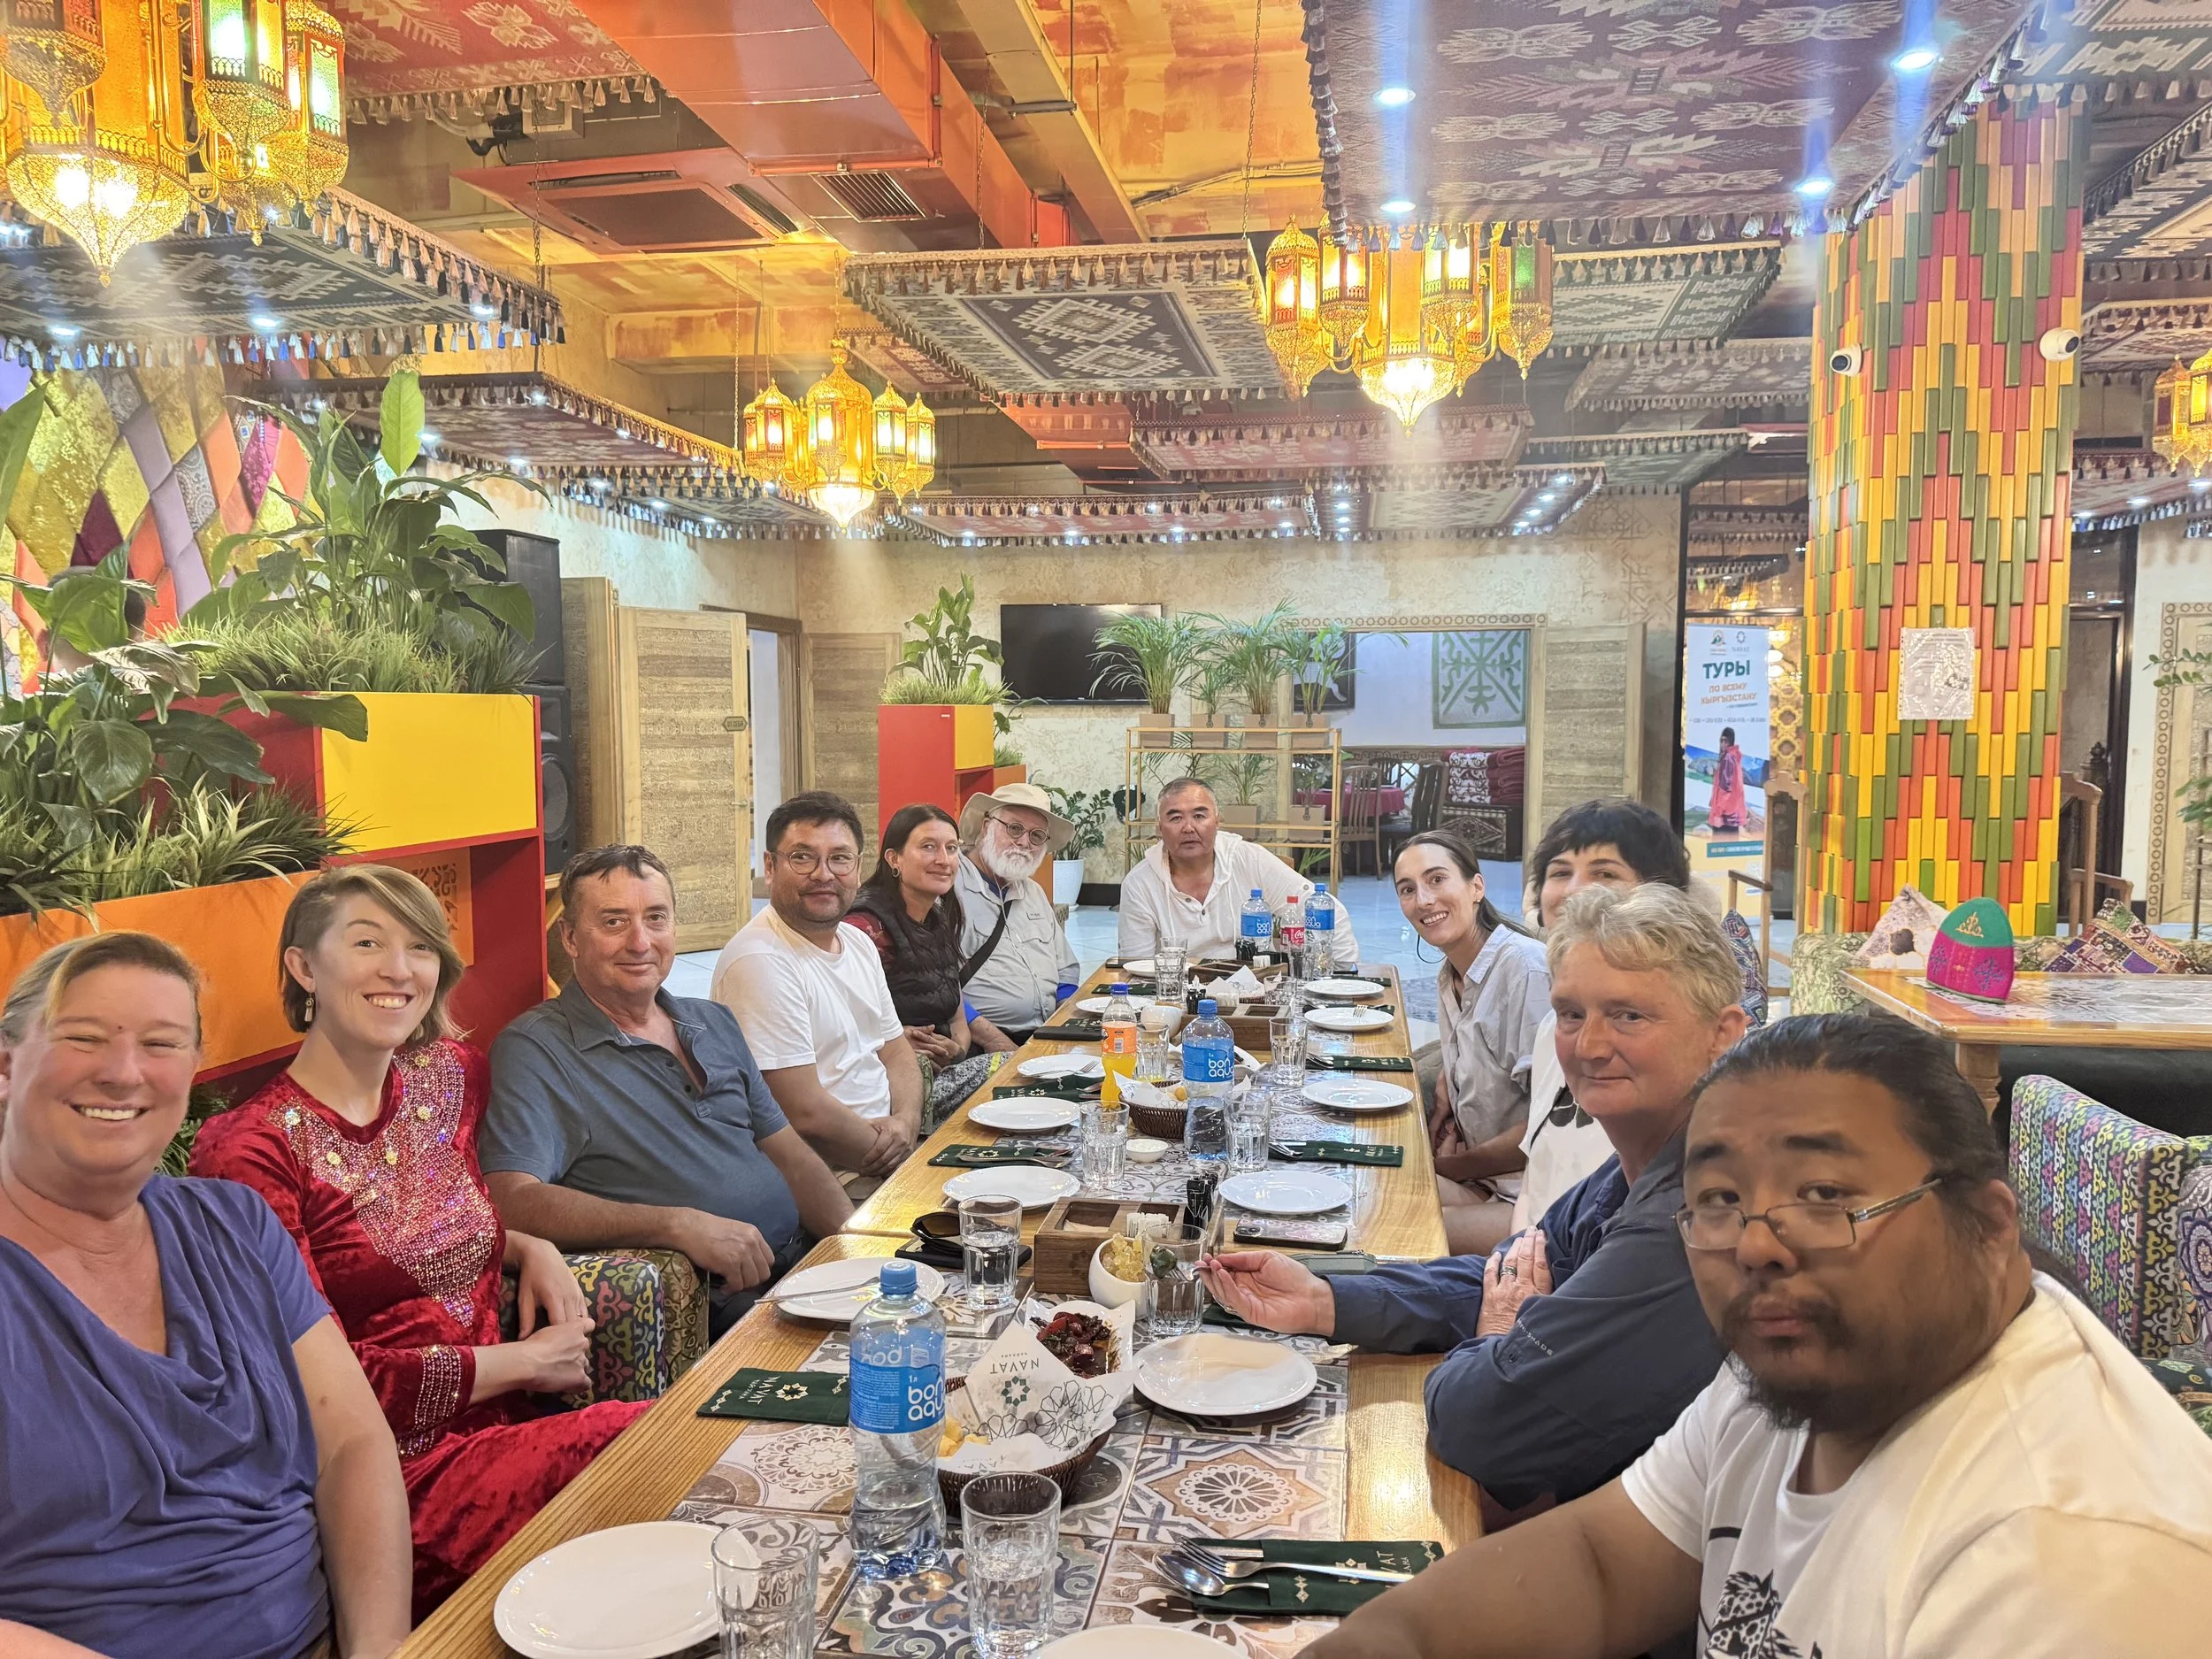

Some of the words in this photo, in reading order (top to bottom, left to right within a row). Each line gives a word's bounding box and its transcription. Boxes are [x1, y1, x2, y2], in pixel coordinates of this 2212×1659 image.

[1701, 659, 1750, 680] ТУРЫ
[1709, 684, 1720, 694] ПО
[1722, 682, 1747, 692] ВСЕМУ
[1208, 1057, 1231, 1069] bon
[989, 1358, 1040, 1374] NAVAT
[748, 1375, 781, 1405] NAVAT
[908, 1376, 944, 1405] bon
